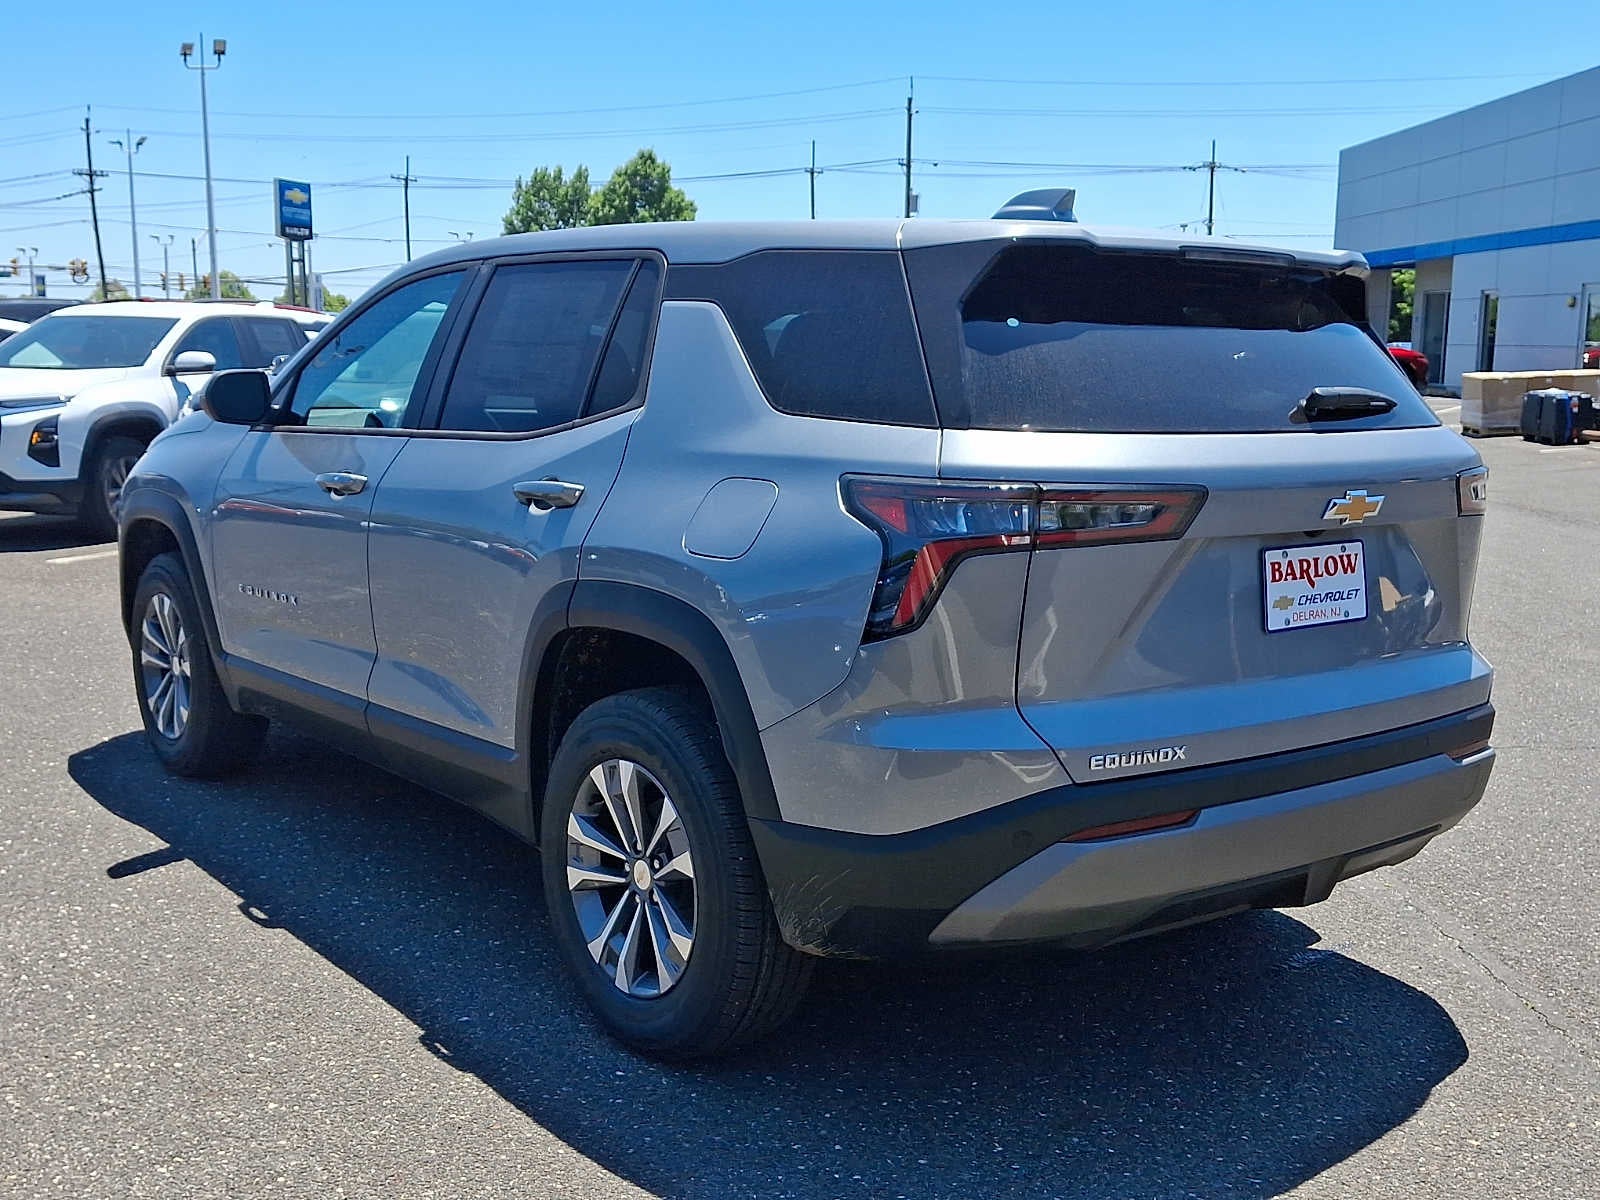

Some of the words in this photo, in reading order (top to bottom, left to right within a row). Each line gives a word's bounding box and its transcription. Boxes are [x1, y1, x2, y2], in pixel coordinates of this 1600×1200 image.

[1270, 553, 1358, 589] BARLOW
[239, 583, 297, 606] EQUINOX
[1298, 589, 1360, 606] CHEVROLET
[1293, 609, 1329, 622] DELRAN,
[1331, 607, 1342, 617] NJ
[1090, 745, 1187, 770] EQUINOX
